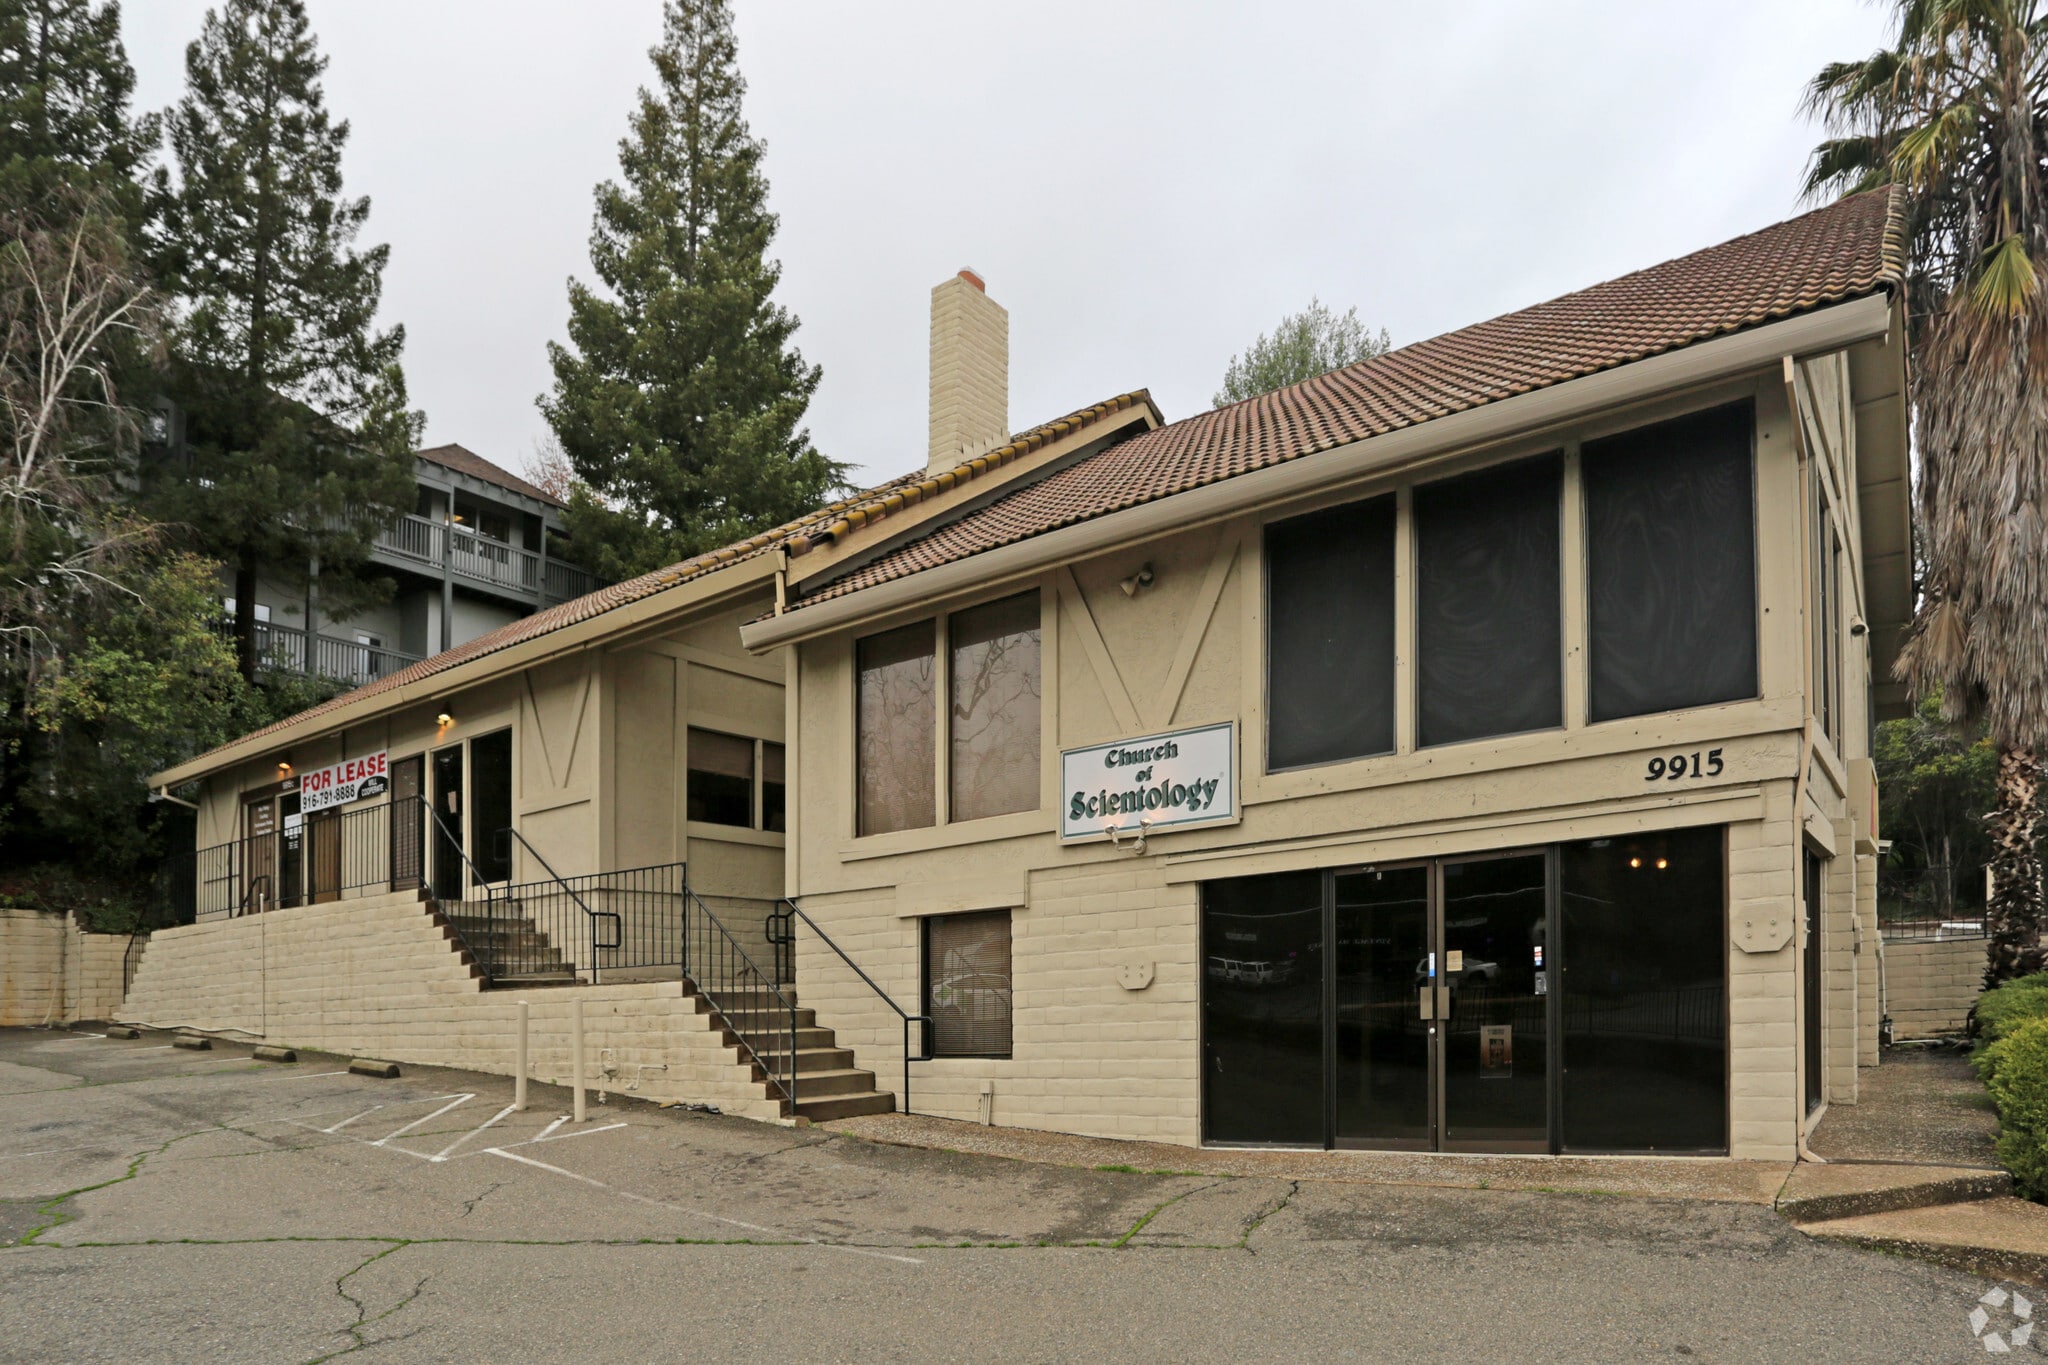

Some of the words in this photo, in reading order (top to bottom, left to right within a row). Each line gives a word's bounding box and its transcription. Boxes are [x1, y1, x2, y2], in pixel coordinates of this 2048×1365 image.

[1105, 740, 1178, 768] Church
[1644, 747, 1724, 781] 9915
[302, 769, 331, 794] FOR
[336, 752, 386, 785] LEASE
[1135, 765, 1153, 782] of
[302, 784, 355, 809] 916-791-8888
[1069, 777, 1219, 820] Scientology
